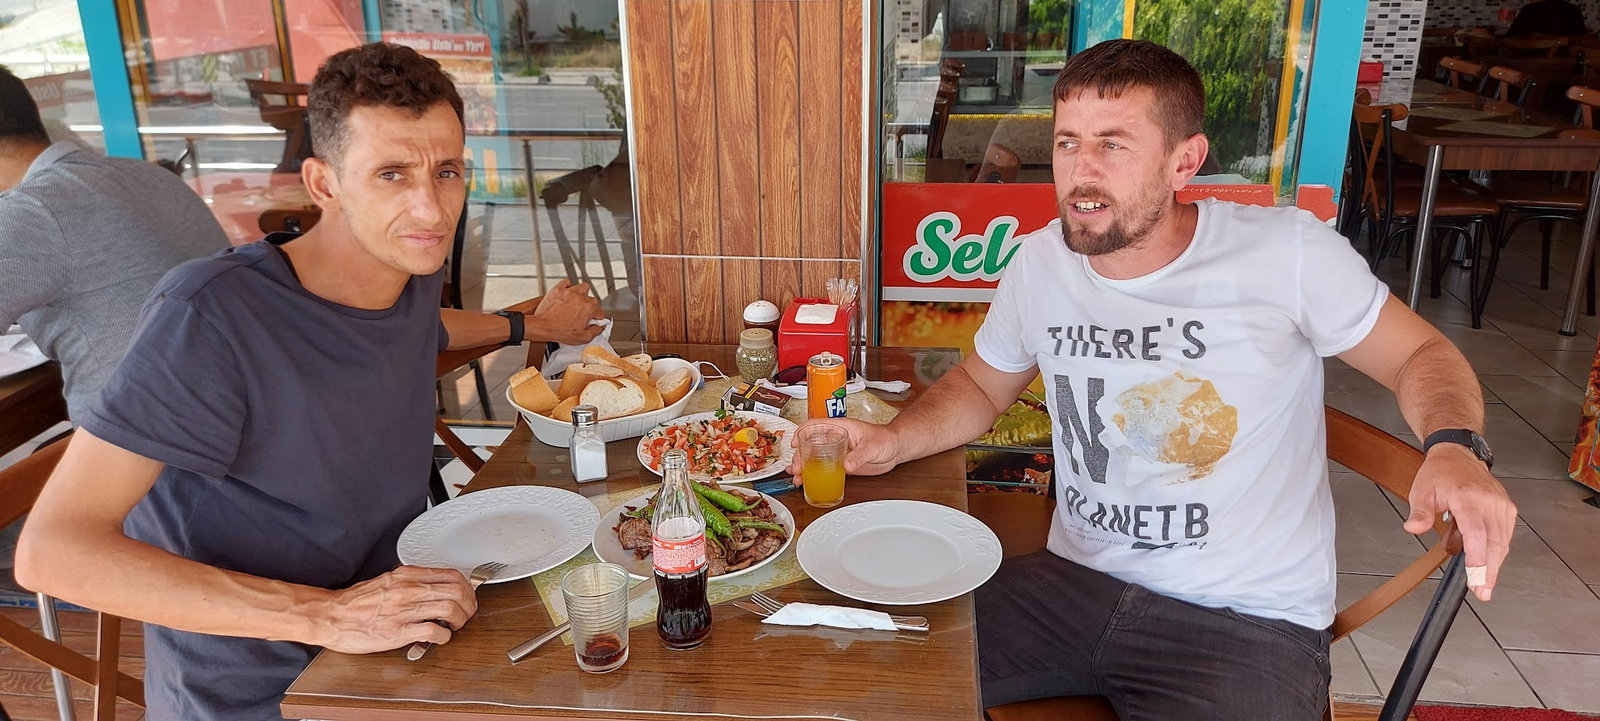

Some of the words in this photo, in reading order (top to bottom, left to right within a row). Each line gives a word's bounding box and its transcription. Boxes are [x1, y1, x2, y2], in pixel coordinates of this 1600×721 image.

[908, 216, 1024, 278] Sel
[1047, 317, 1207, 361] THERE'S
[826, 397, 847, 418] FA
